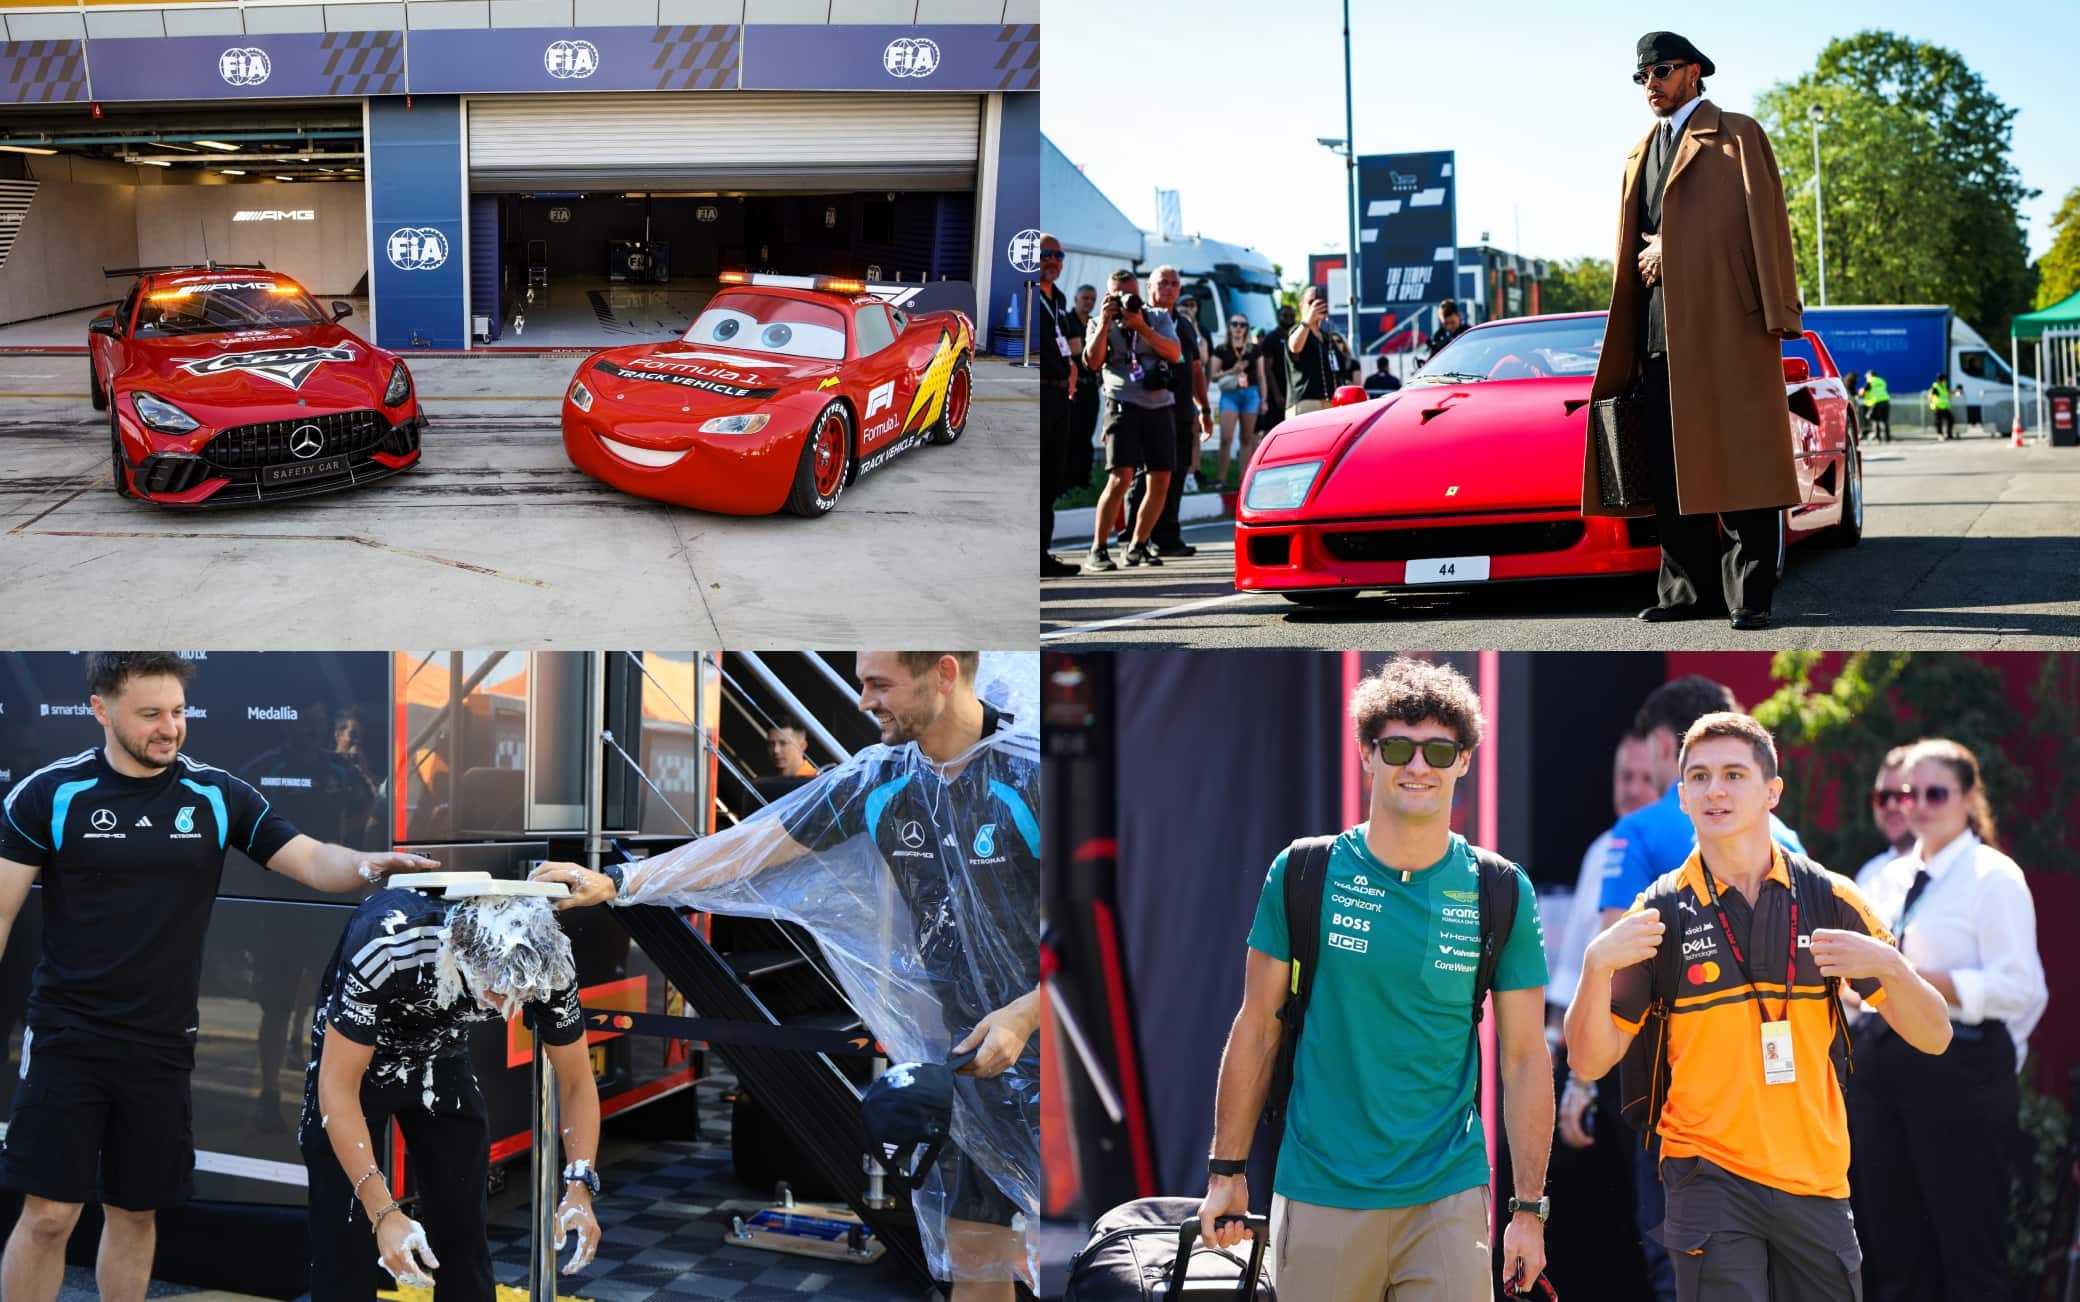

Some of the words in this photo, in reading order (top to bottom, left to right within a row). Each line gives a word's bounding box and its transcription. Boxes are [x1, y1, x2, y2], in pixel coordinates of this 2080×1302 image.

[616, 368, 671, 381] TRACK
[672, 376, 750, 397] VEHICLE
[859, 456, 885, 476] TRACK
[886, 434, 915, 462] VEHICLE
[273, 464, 314, 479] SAFETY
[319, 460, 339, 471] CAR
[1439, 563, 1456, 576] 44
[51, 703, 95, 716] smartshe
[248, 706, 298, 720] Medallia
[969, 856, 1006, 865] PETRONAS
[1331, 894, 1383, 912] cognizant
[1332, 912, 1371, 932] BOSS
[1329, 935, 1367, 952] JCB
[1682, 936, 1717, 955] DELL
